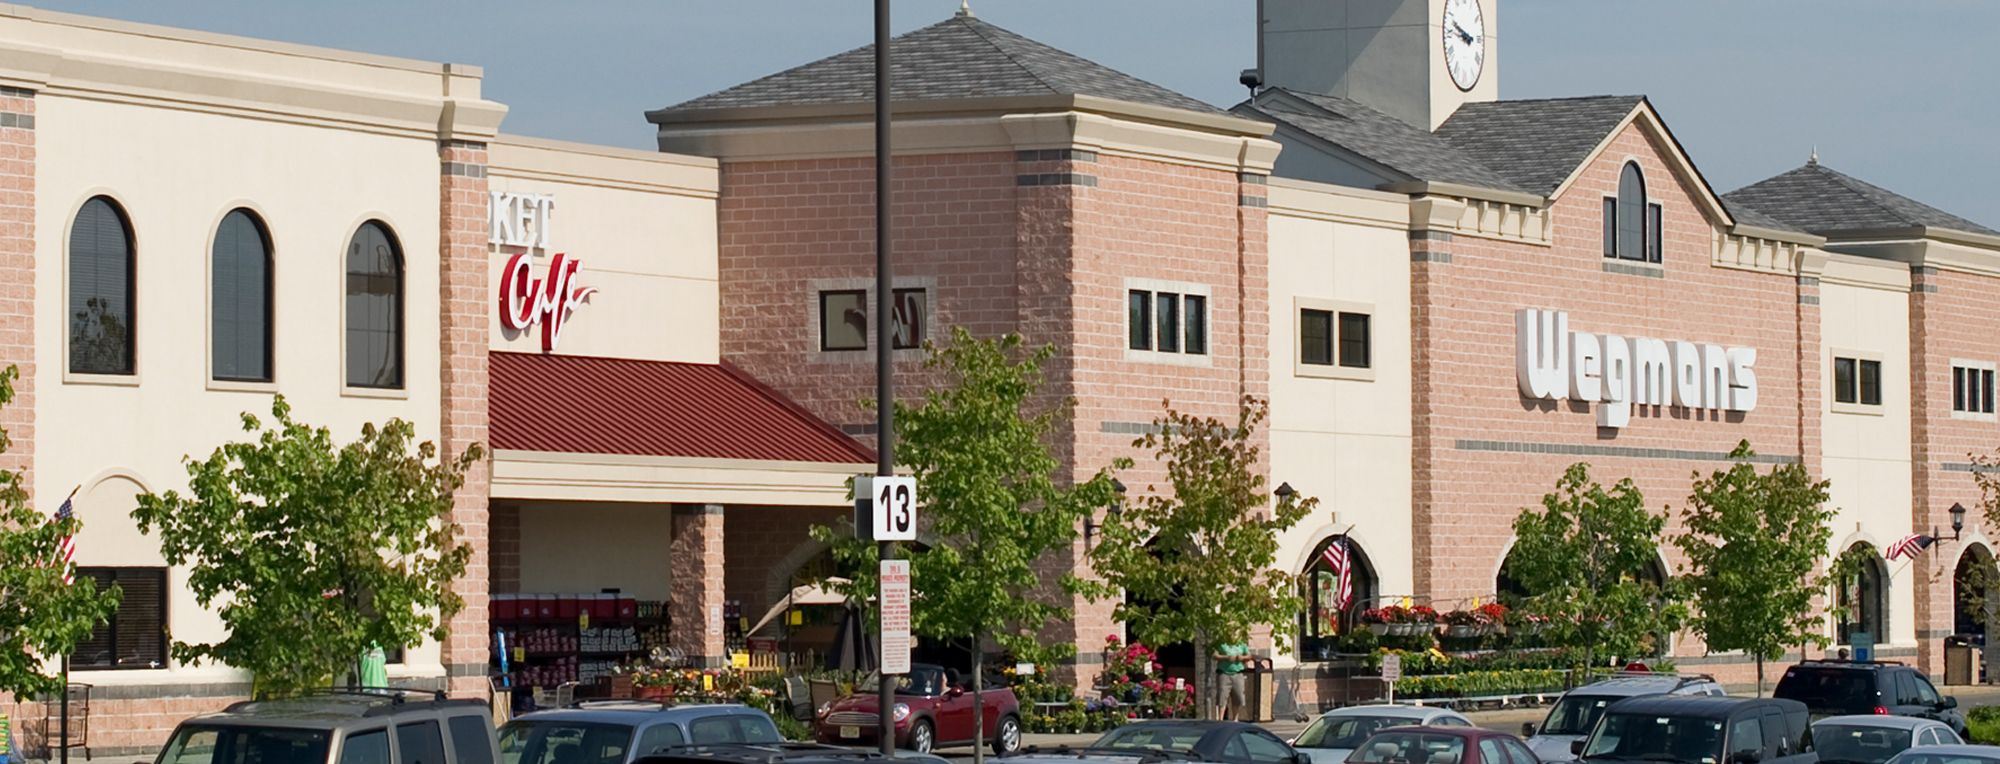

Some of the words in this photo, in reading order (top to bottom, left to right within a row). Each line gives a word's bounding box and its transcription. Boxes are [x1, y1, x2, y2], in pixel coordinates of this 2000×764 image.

[489, 192, 555, 249] KET
[1516, 308, 1758, 428] Wegmans
[880, 484, 910, 533] 13
